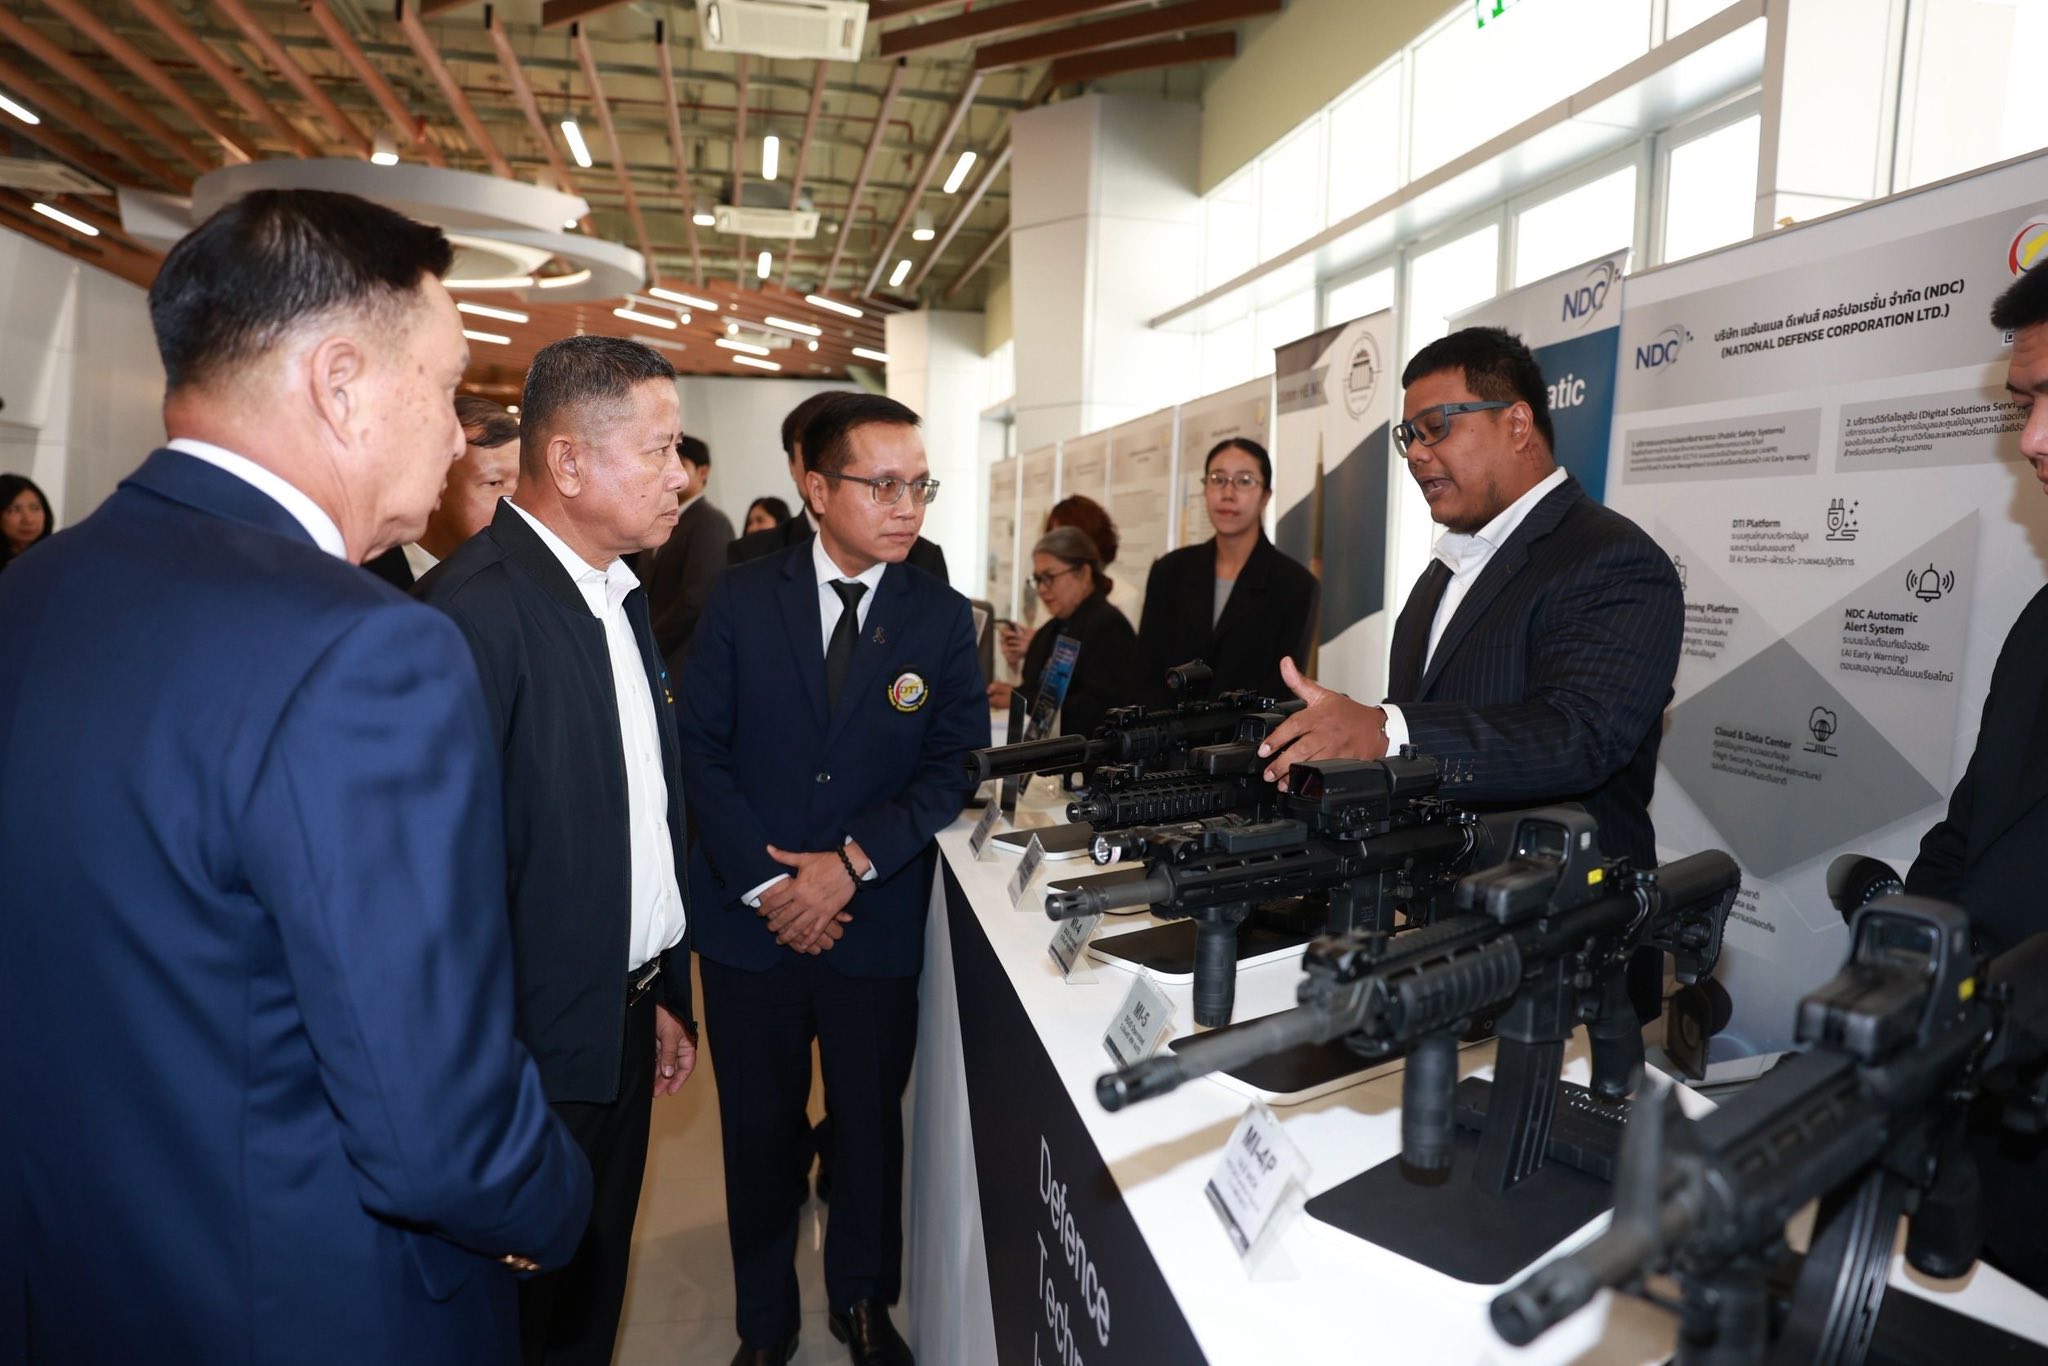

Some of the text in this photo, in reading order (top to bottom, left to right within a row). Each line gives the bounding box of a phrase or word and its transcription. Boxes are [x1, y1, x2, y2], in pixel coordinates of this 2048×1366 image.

[1562, 281, 1605, 322] NDC
[1714, 327, 1739, 342] บริษัท
[1785, 308, 1821, 328] ดีเฟนส์
[1889, 289, 1921, 306] จำกัด
[1924, 279, 1965, 300] (NDC)
[1721, 303, 1950, 359] (NATIONAL DEFENSE CORPORATION LTD.)
[1636, 340, 1678, 370] NDC
[1547, 373, 1585, 411] atic
[1919, 407, 1949, 420] (Digital
[1950, 404, 1991, 416] Solutions
[1993, 402, 2017, 412] Servi
[1732, 518, 1781, 528] DTI Platform
[1706, 603, 1739, 614] Platform
[1845, 608, 1919, 623] NDC Automatic
[1844, 622, 1904, 635] Alert System
[1841, 648, 1909, 665] (AI Early Warning)
[1714, 726, 1792, 749] Cloud & Data Center
[1133, 1001, 1150, 1028] MI-5
[1242, 1125, 1277, 1176] MI-4P
[1040, 1133, 1110, 1347] Defence
